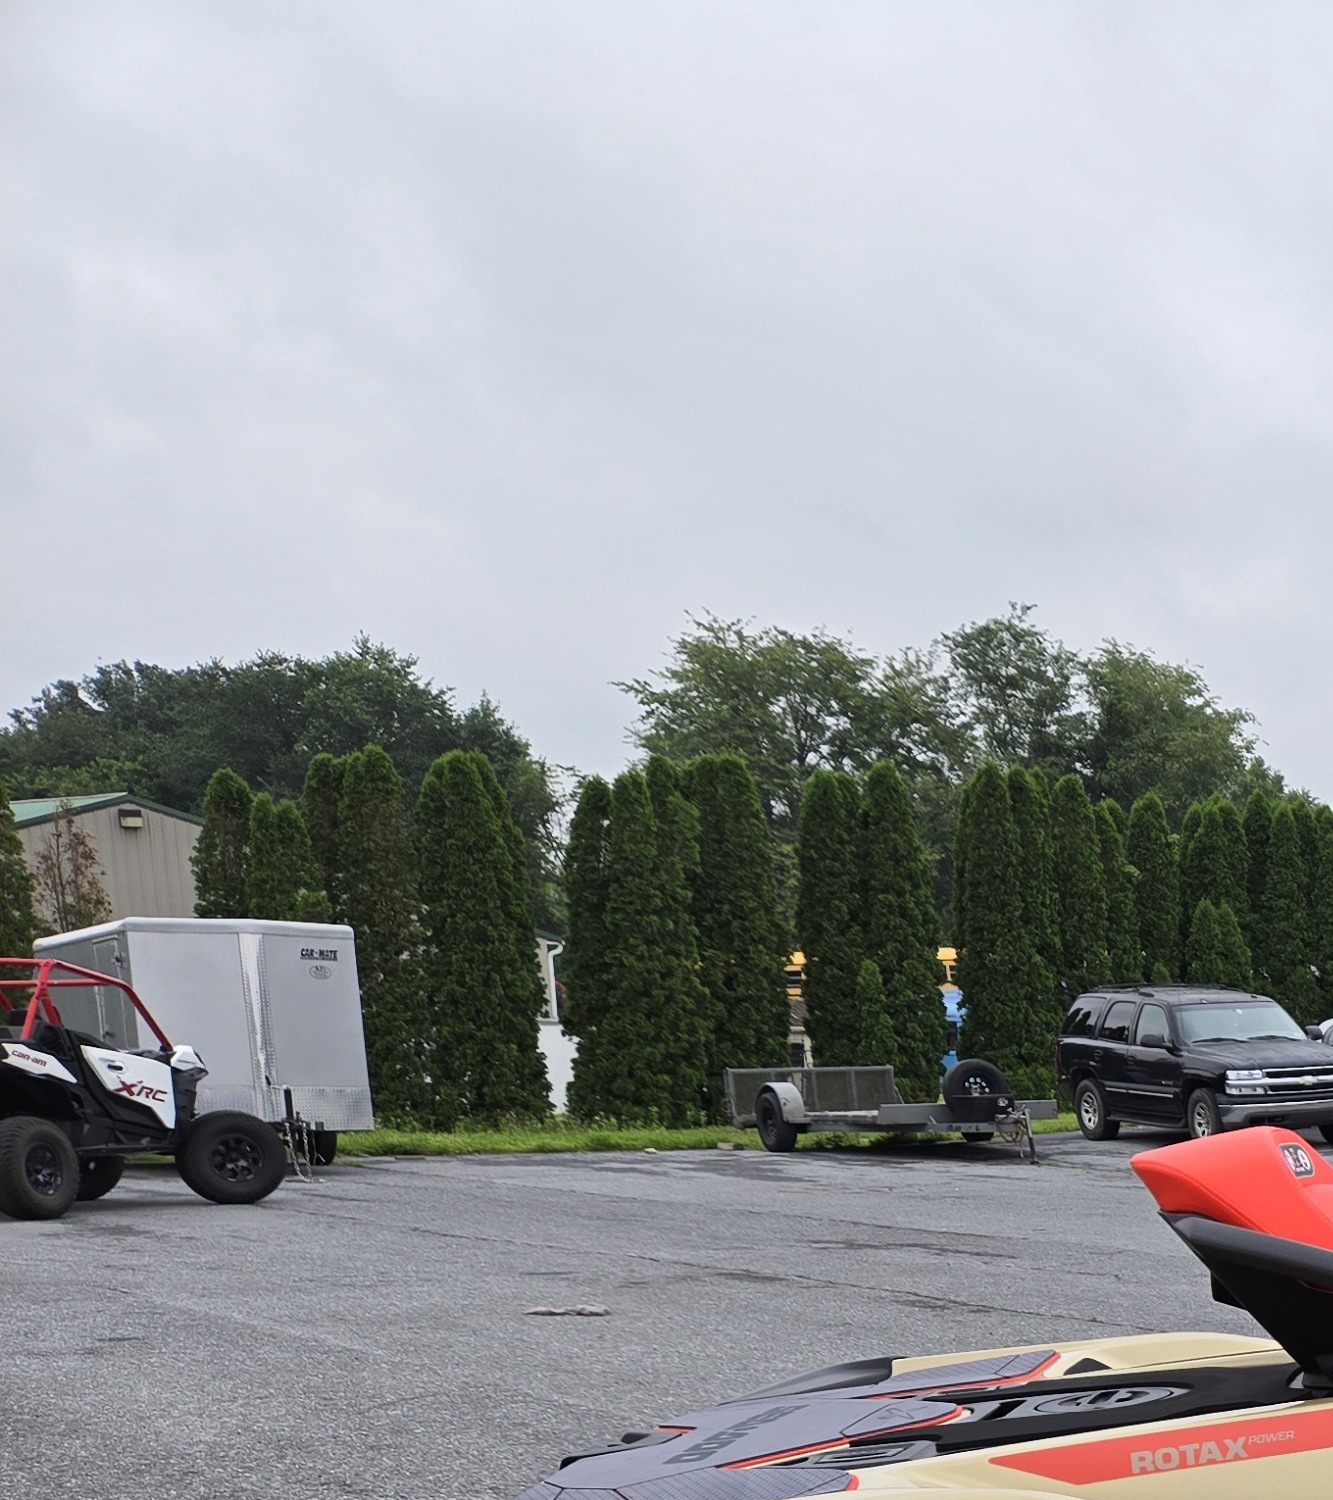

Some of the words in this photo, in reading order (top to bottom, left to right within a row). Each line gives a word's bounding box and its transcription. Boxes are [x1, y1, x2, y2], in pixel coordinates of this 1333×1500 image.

[113, 1075, 168, 1103] XRC
[1130, 1436, 1249, 1475] ROTAX
[1247, 1430, 1295, 1446] POWER
